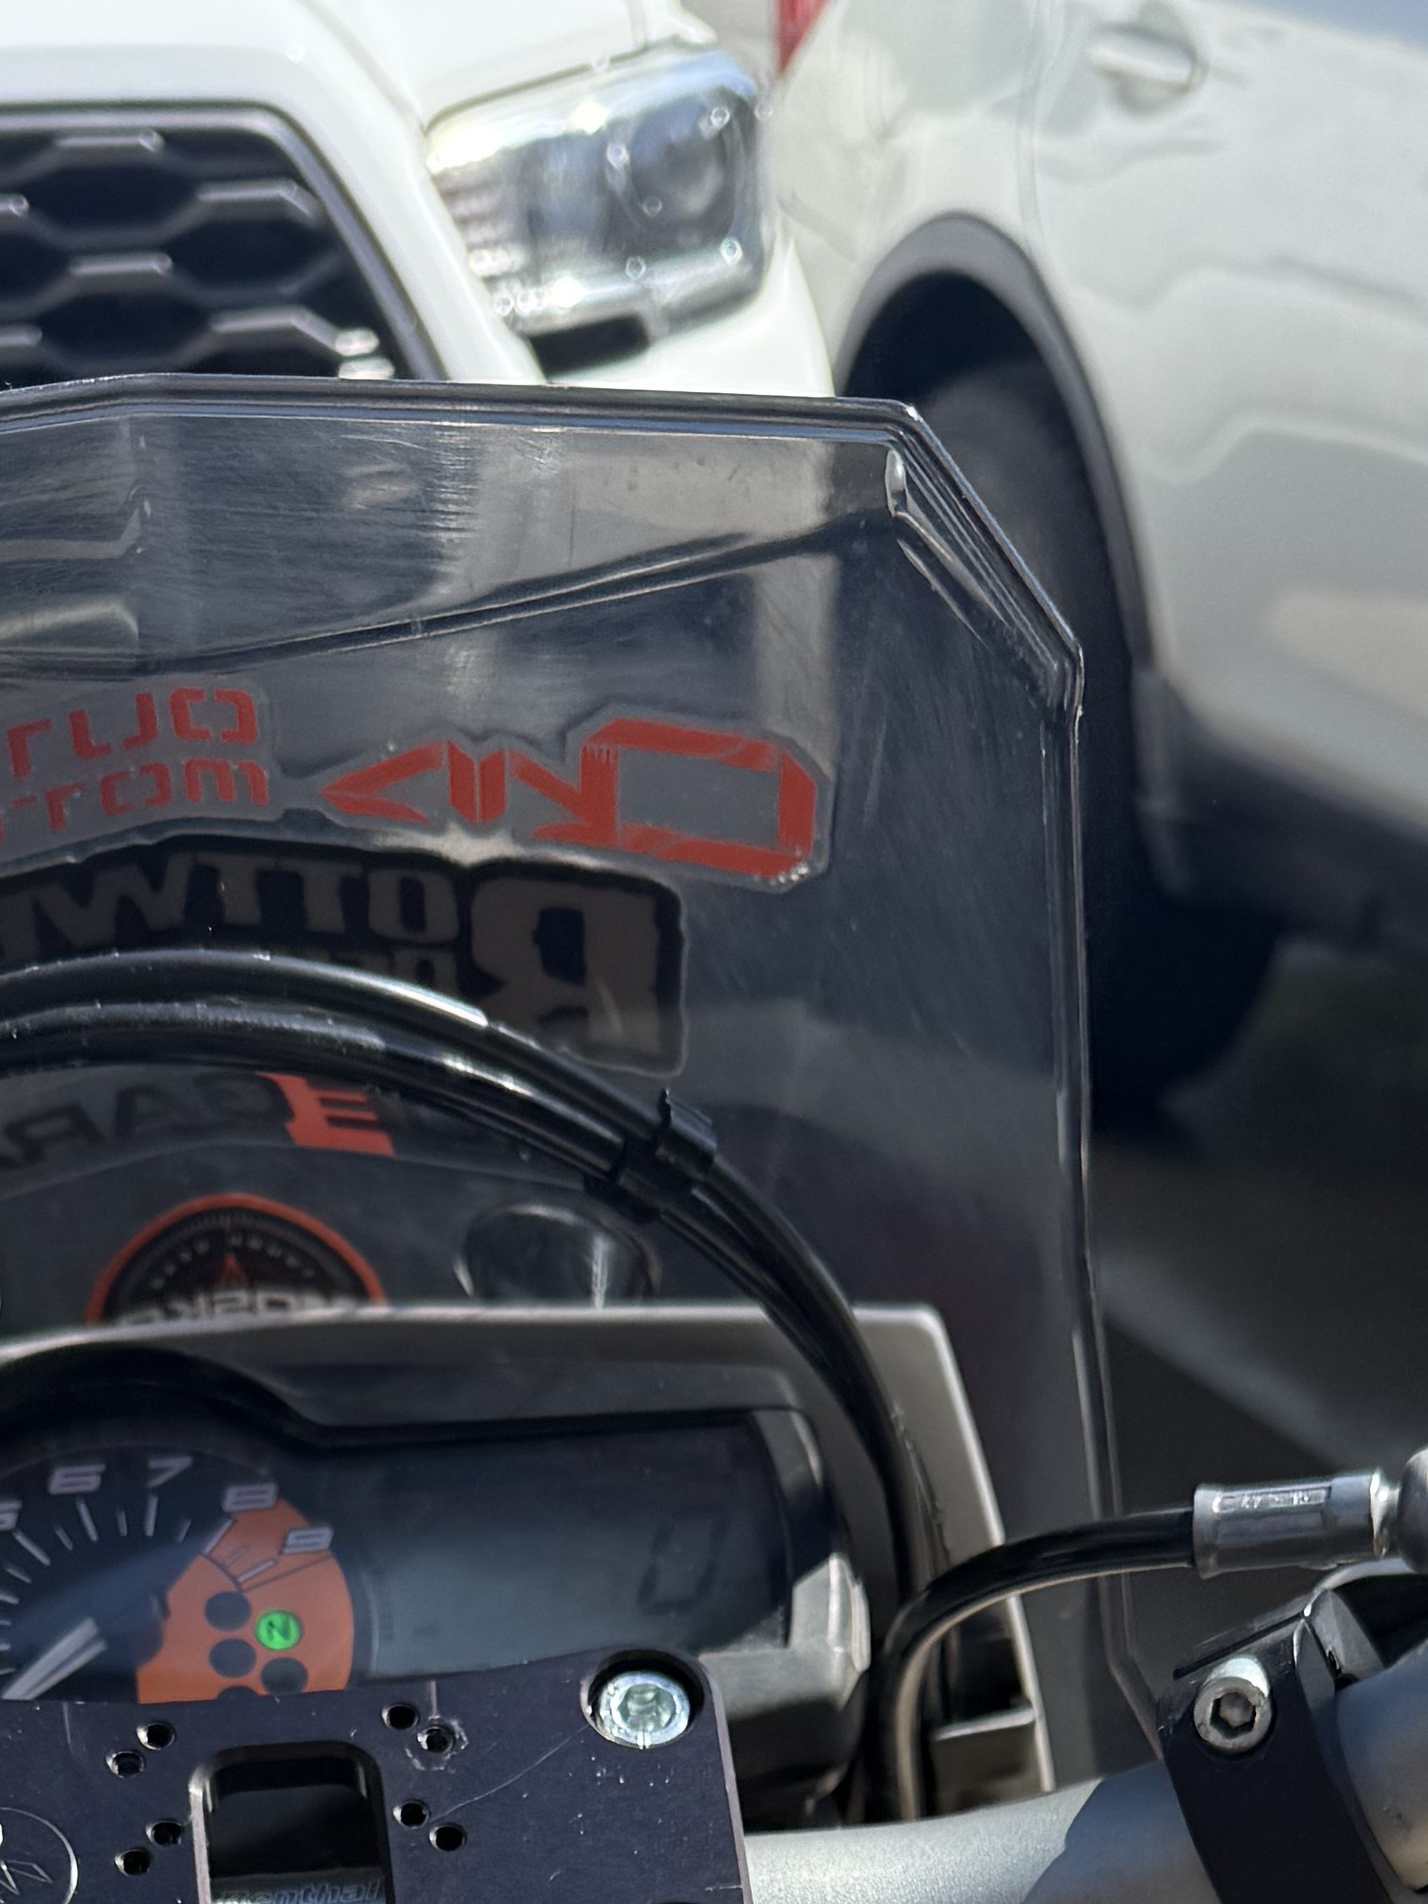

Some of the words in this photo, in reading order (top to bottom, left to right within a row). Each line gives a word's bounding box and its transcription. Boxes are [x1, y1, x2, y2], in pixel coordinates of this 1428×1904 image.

[48, 1462, 106, 1495] 6
[145, 1455, 194, 1488] 7
[221, 1482, 278, 1513] 8
[280, 1524, 334, 1557] 9
